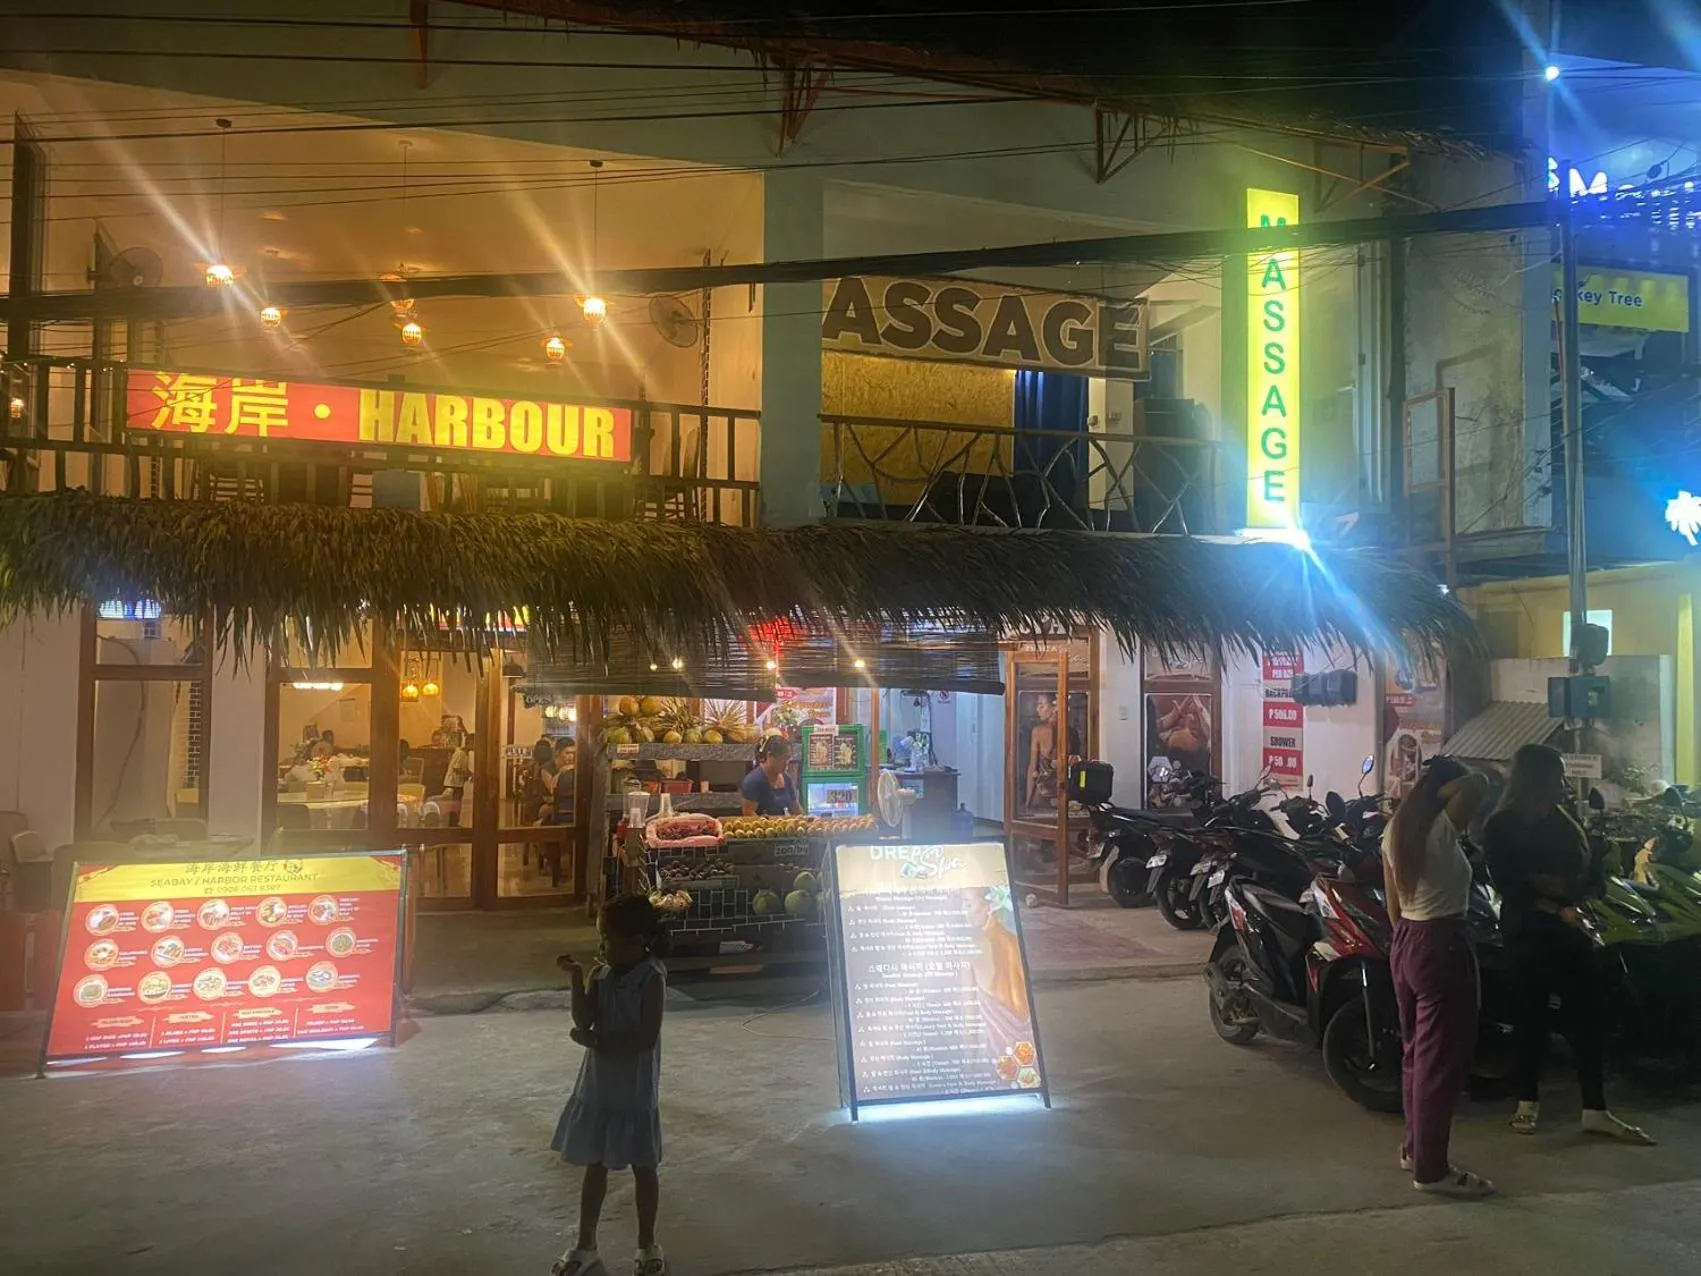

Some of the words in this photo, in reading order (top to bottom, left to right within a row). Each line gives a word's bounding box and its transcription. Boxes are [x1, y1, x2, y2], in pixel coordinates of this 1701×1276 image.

[1608, 290, 1643, 308] Tree
[151, 370, 289, 437] 海岸
[359, 388, 615, 458] HARBOUR
[1270, 736, 1296, 747] SHOWER
[250, 872, 319, 882] RESTAURANT
